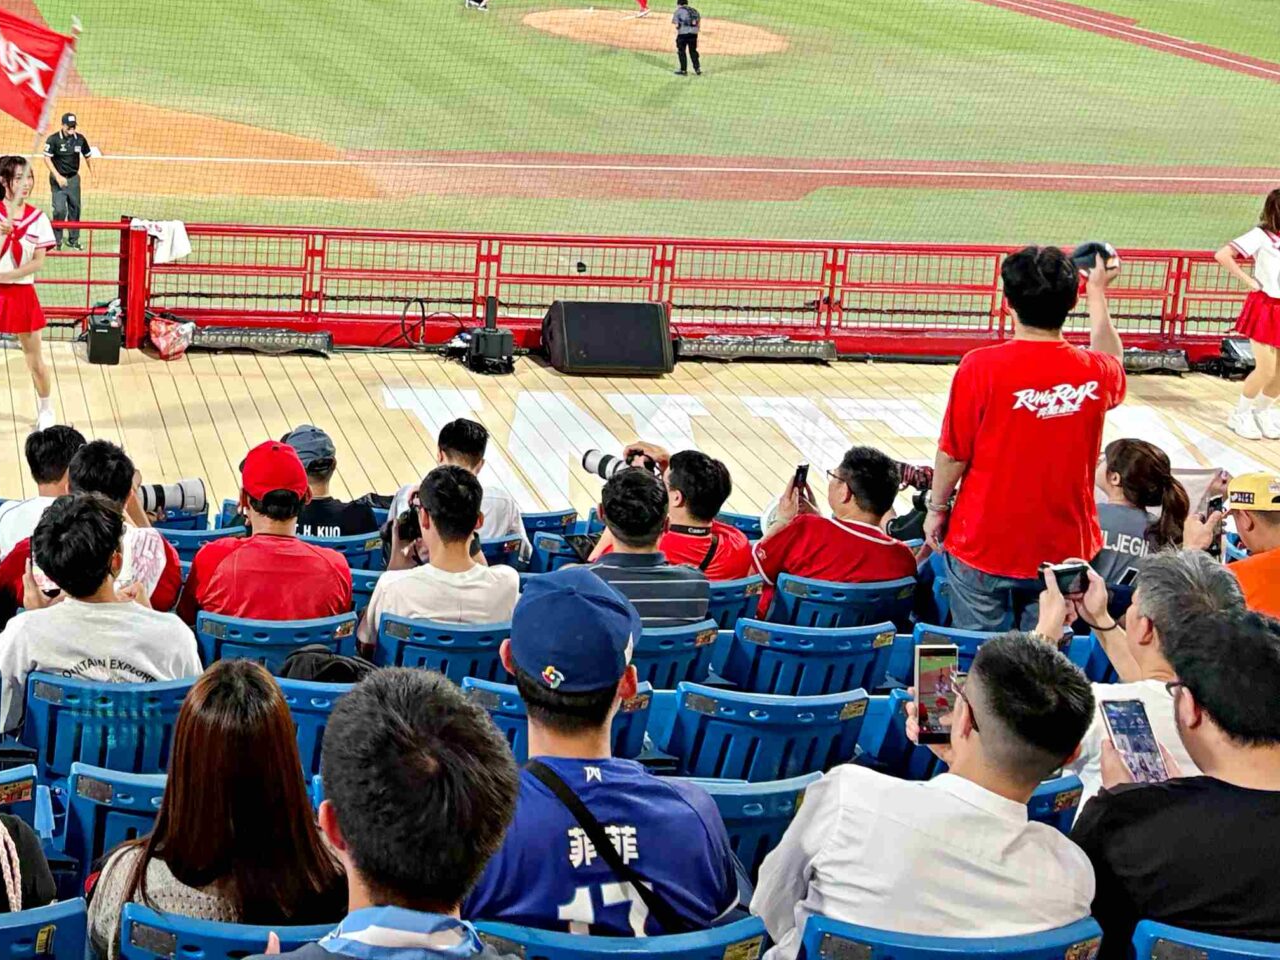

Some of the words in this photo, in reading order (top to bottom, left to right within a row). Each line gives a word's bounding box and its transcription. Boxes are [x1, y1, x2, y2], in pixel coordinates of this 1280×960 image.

[317, 525, 341, 538] KUO
[567, 825, 640, 869] 菲菲
[558, 880, 653, 939] 17
